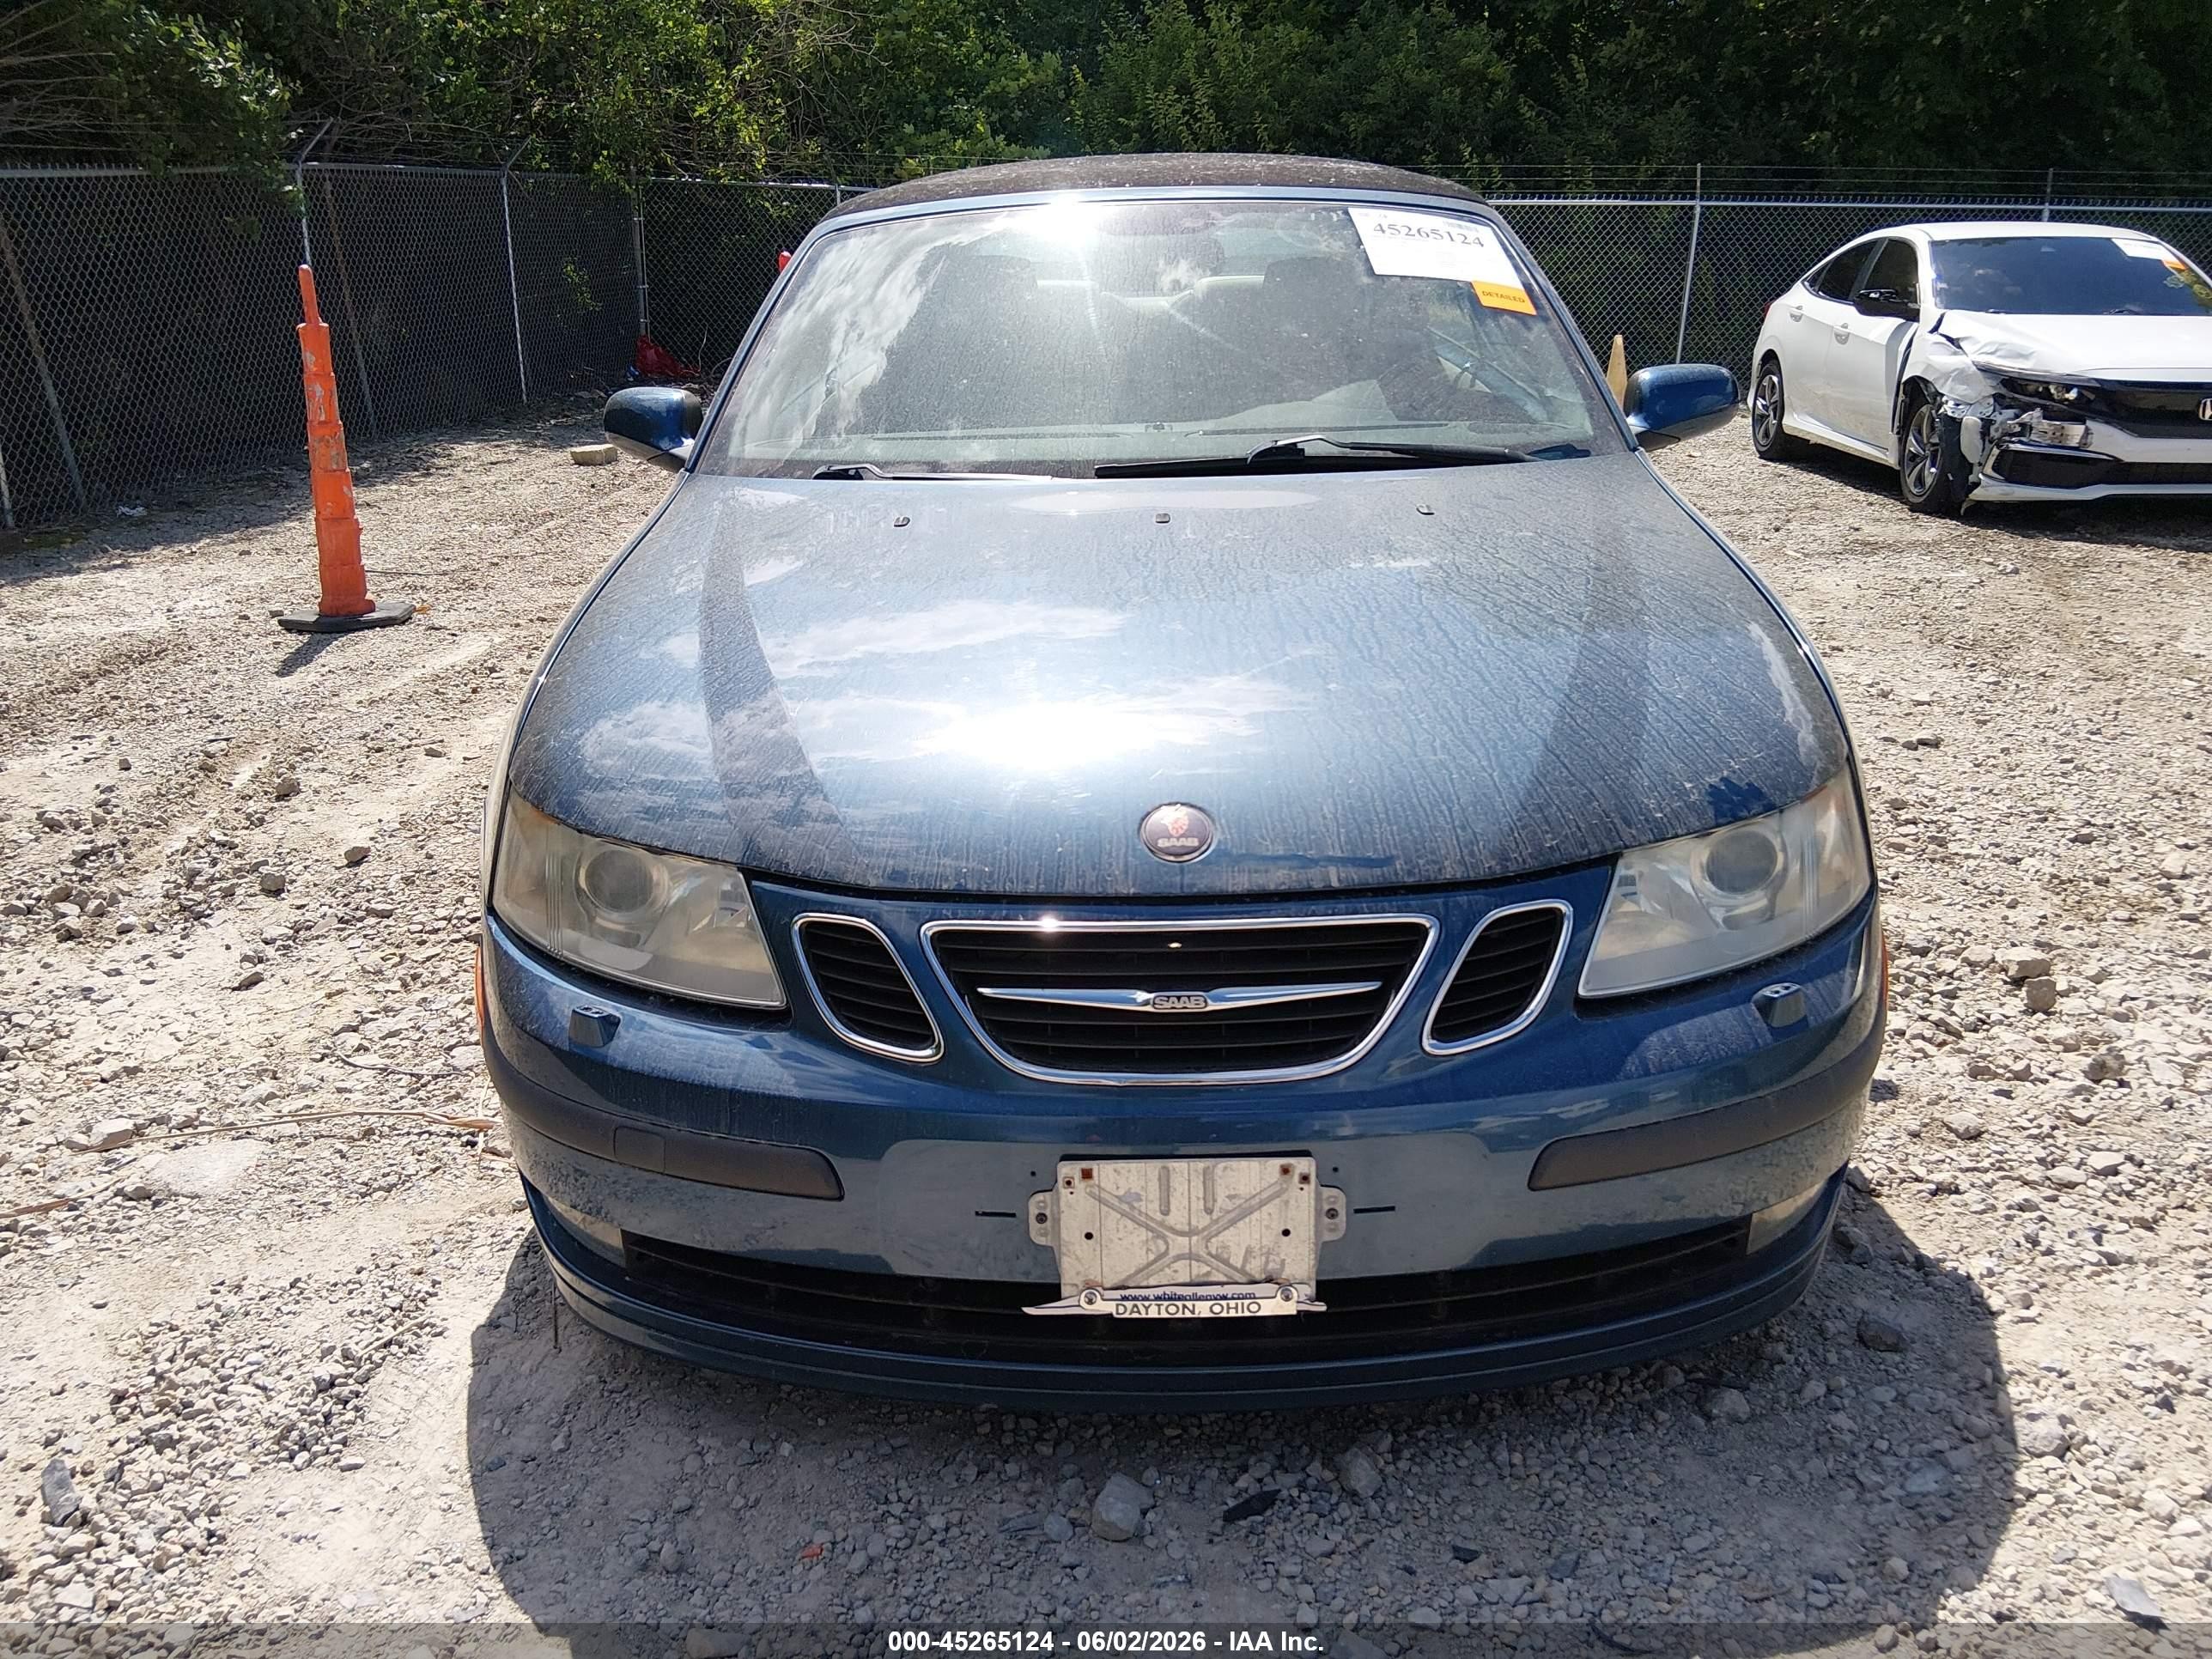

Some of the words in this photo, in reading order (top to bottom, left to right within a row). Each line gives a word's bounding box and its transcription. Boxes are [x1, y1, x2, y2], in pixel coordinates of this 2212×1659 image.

[1373, 222, 1484, 247] 45265124
[1481, 290, 1526, 303] DETAILED
[1153, 996, 1206, 1009] SAAB
[1116, 1303, 1201, 1316] DAYTON,
[1209, 1301, 1261, 1315] OHIO
